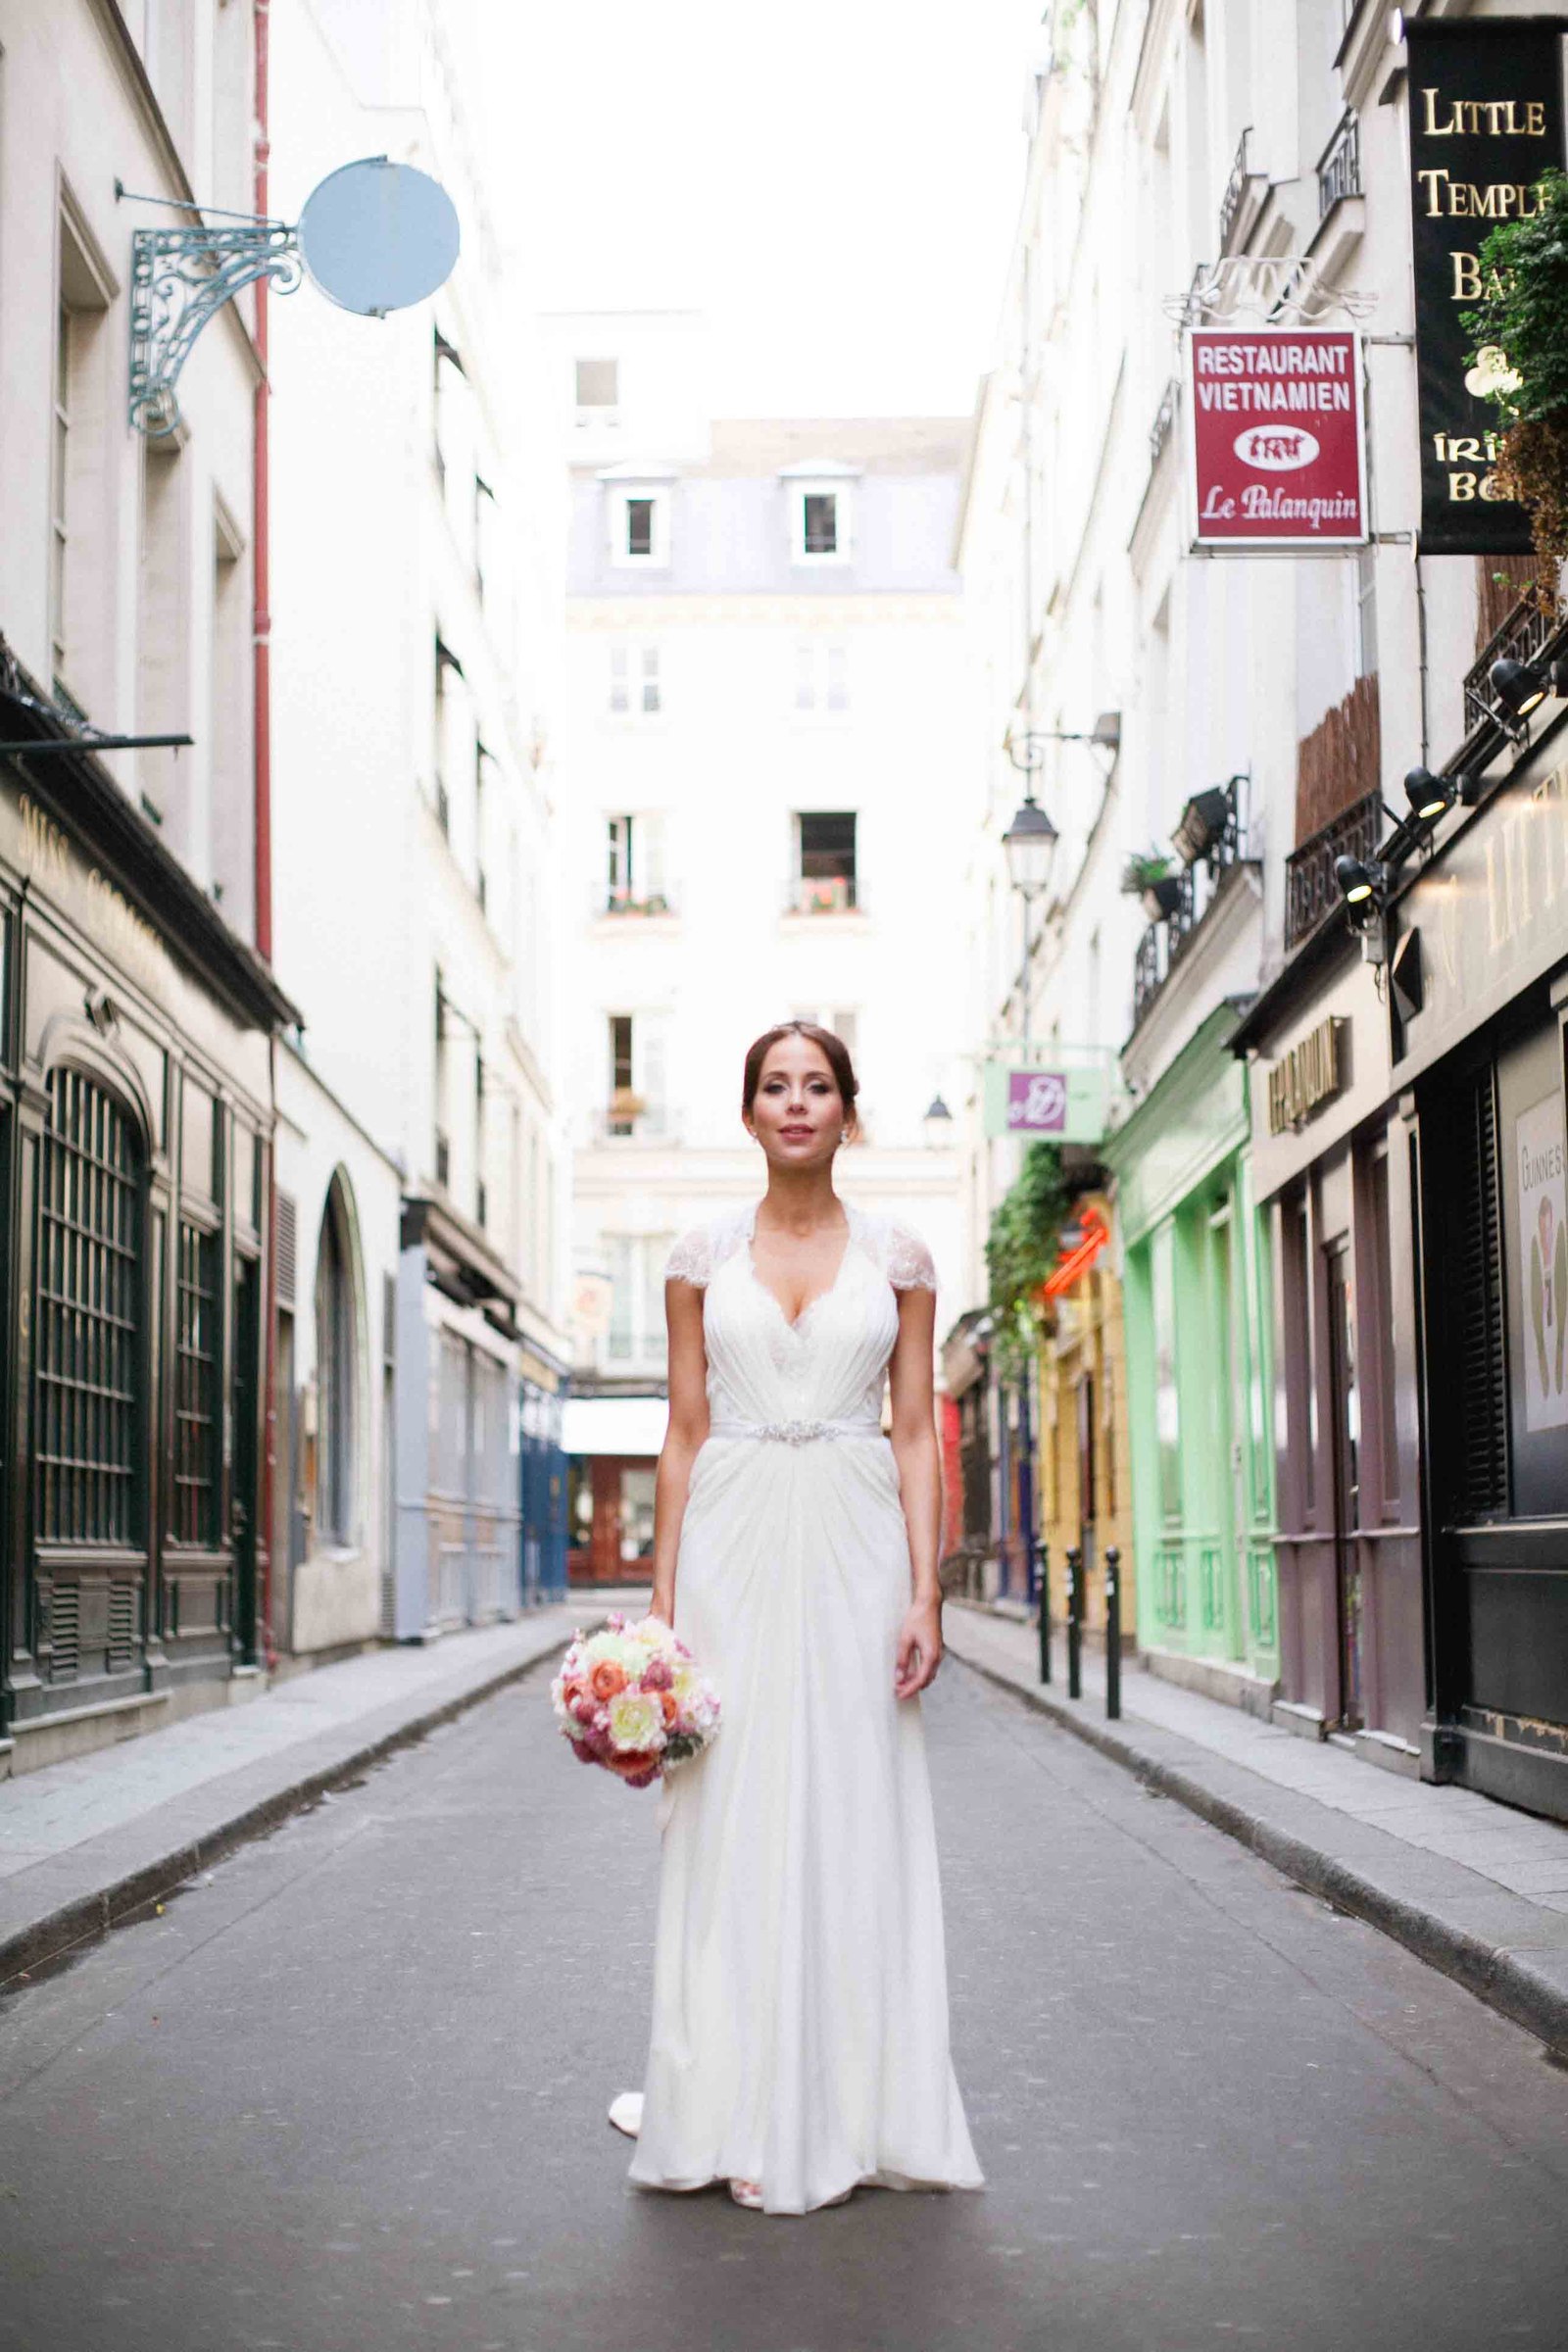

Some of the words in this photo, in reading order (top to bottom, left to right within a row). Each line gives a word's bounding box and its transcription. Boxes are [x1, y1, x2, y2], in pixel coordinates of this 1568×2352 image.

[1421, 87, 1546, 136] LITTLE
[1198, 345, 1348, 375] RESTAURANT
[1198, 381, 1350, 412] VIETNAMIEN
[1200, 484, 1237, 520] Le
[1241, 483, 1358, 530] Palanquin
